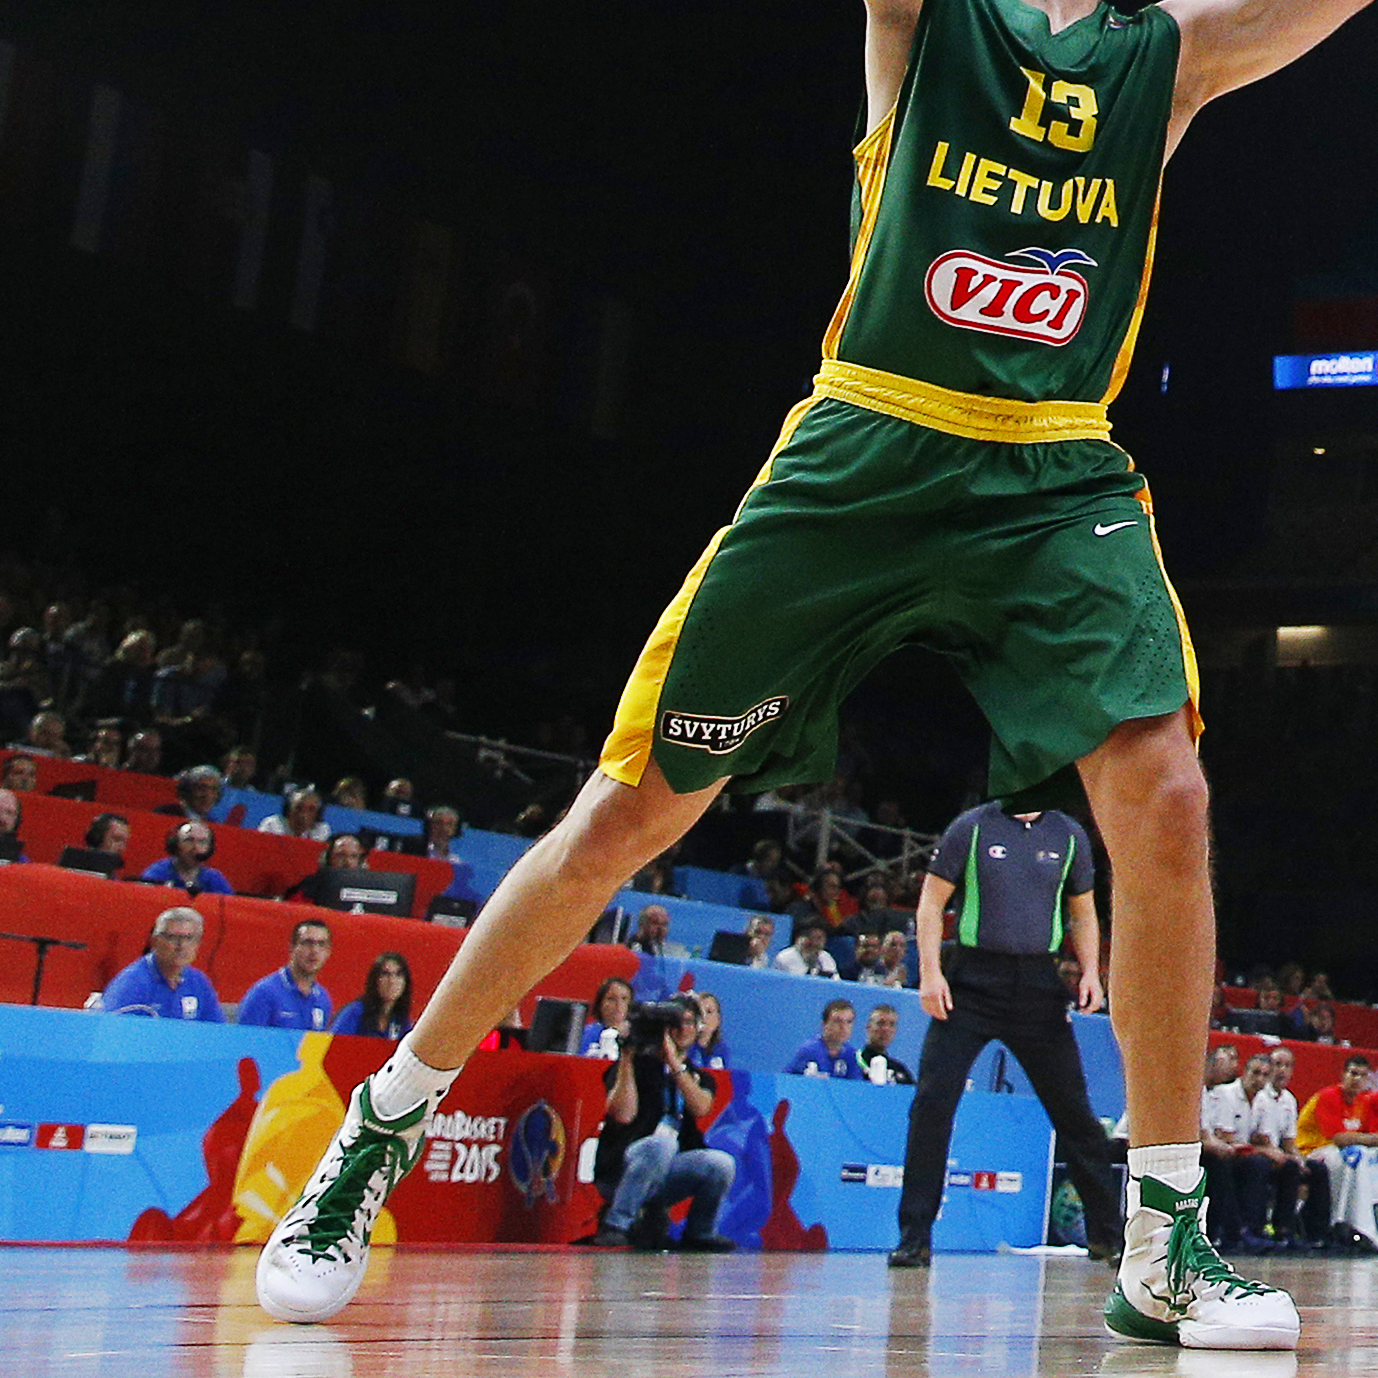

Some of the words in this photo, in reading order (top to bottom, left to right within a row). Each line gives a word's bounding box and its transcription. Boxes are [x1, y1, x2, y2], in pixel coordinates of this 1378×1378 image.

[1010, 67, 1098, 152] 13
[926, 140, 1119, 227] LIETUVA
[950, 267, 1081, 330] VICI
[1309, 355, 1373, 376] molten
[450, 1142, 503, 1183] 2015
